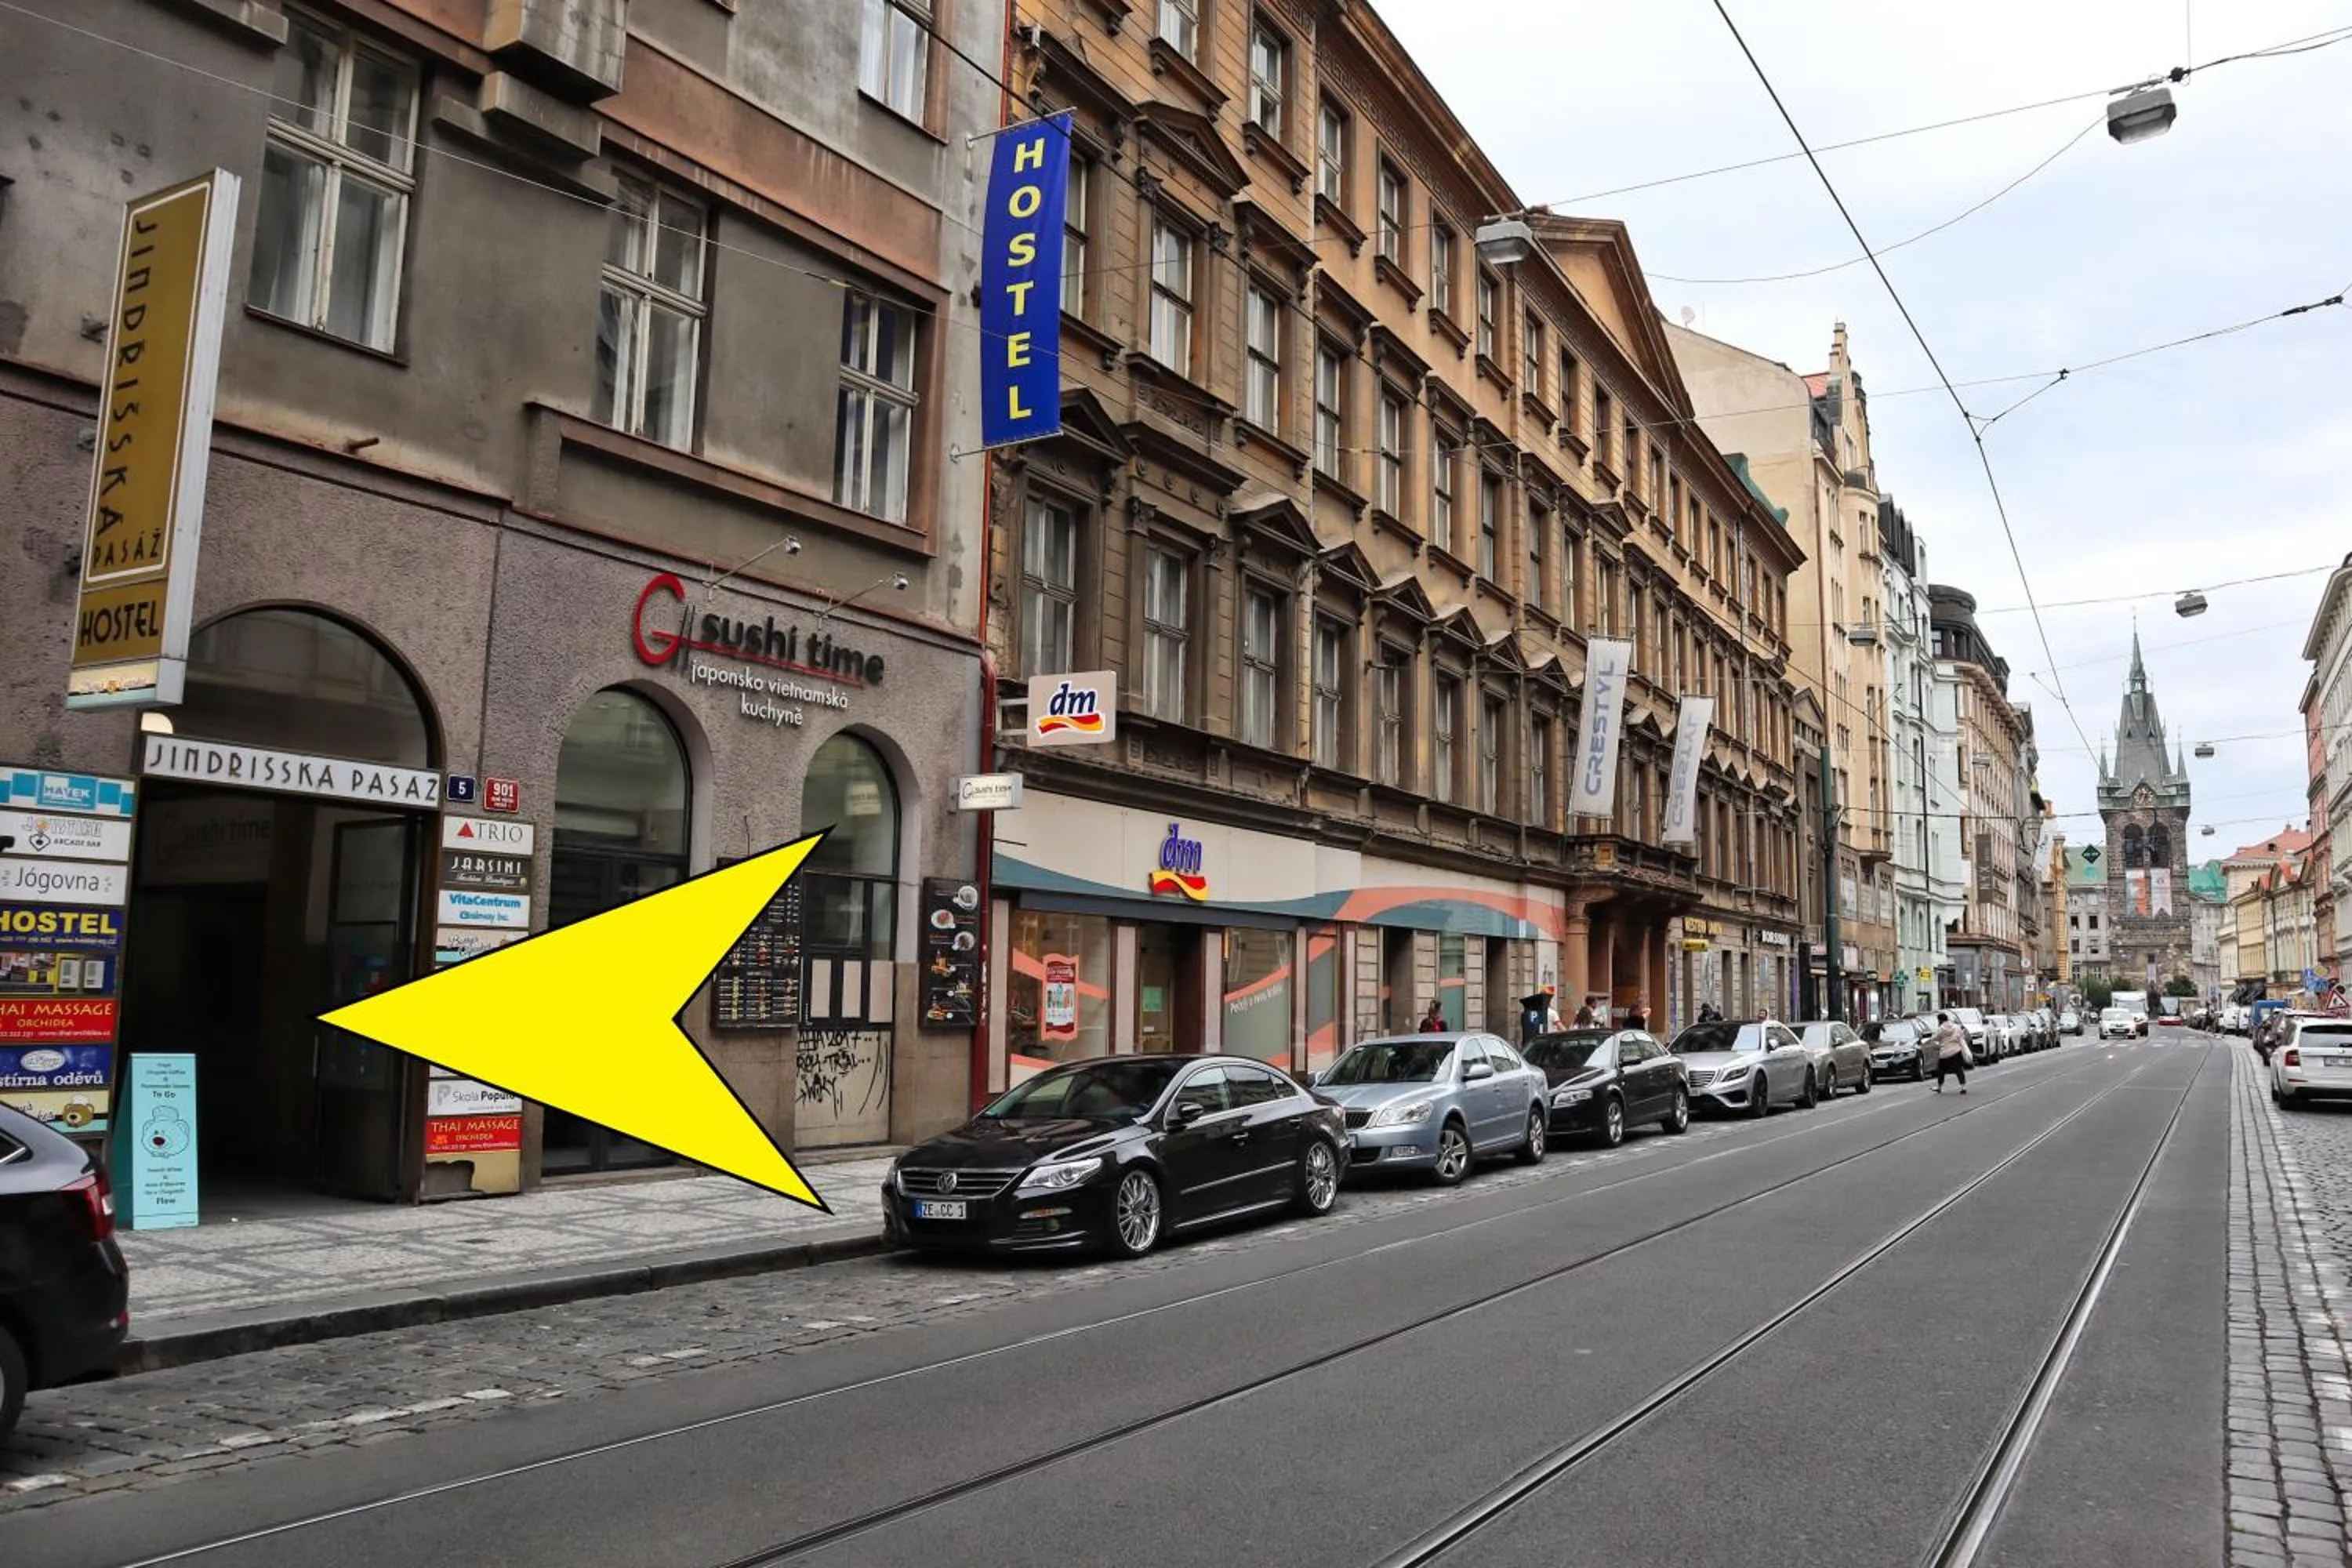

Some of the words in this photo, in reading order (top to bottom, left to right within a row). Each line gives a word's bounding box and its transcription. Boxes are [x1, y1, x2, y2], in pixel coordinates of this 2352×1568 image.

[1007, 137, 1045, 419] HOSTEL
[93, 528, 162, 568] PASÁŽ
[80, 601, 159, 647] HOSTEL
[700, 612, 797, 662] sushi
[806, 632, 884, 685] time
[691, 659, 764, 691] japonsko
[740, 692, 804, 727] kuchyně
[1049, 683, 1096, 715] dm
[1584, 661, 1614, 796] CRESTYL
[150, 744, 335, 789] JINDRISSKA
[351, 769, 438, 802] PASAZ
[459, 782, 466, 795] 5
[493, 783, 514, 797] 901
[476, 822, 523, 843] TRIO
[1160, 823, 1203, 872] dm
[15, 867, 100, 894] Jógovna
[450, 894, 521, 908] VitaCentrum
[34, 1003, 113, 1015] MASSAGE
[1531, 1011, 1538, 1022] P
[53, 1070, 104, 1086] oděvů
[432, 1121, 461, 1133] THAI
[466, 1119, 518, 1131] MASSAGE
